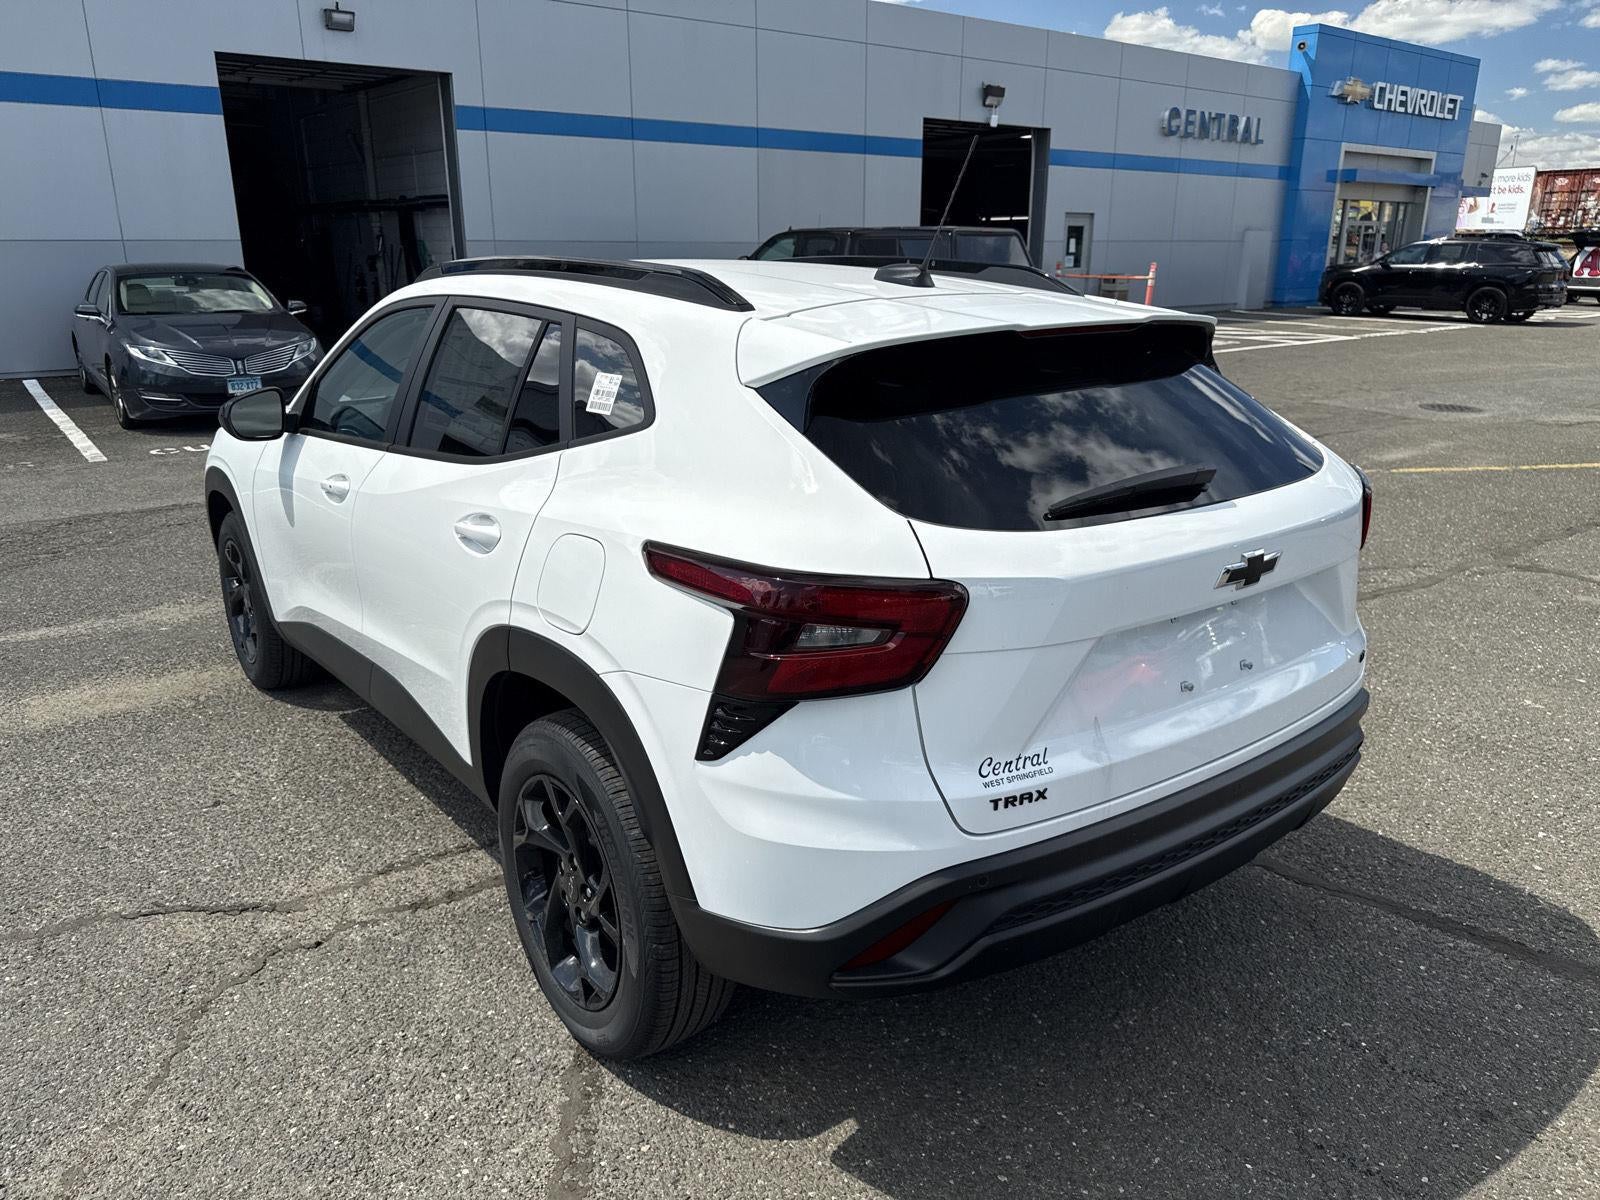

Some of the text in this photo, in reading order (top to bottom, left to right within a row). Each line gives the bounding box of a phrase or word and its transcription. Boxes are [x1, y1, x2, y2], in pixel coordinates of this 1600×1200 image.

[1373, 81, 1464, 121] CHEVROLET
[1161, 106, 1264, 145] CENTRAL
[1497, 172, 1531, 183] more kids
[1497, 184, 1507, 194] be
[978, 746, 1049, 778] Central
[982, 766, 1054, 789] WEST SPRINGFIELD
[988, 787, 1048, 811] TRAX
